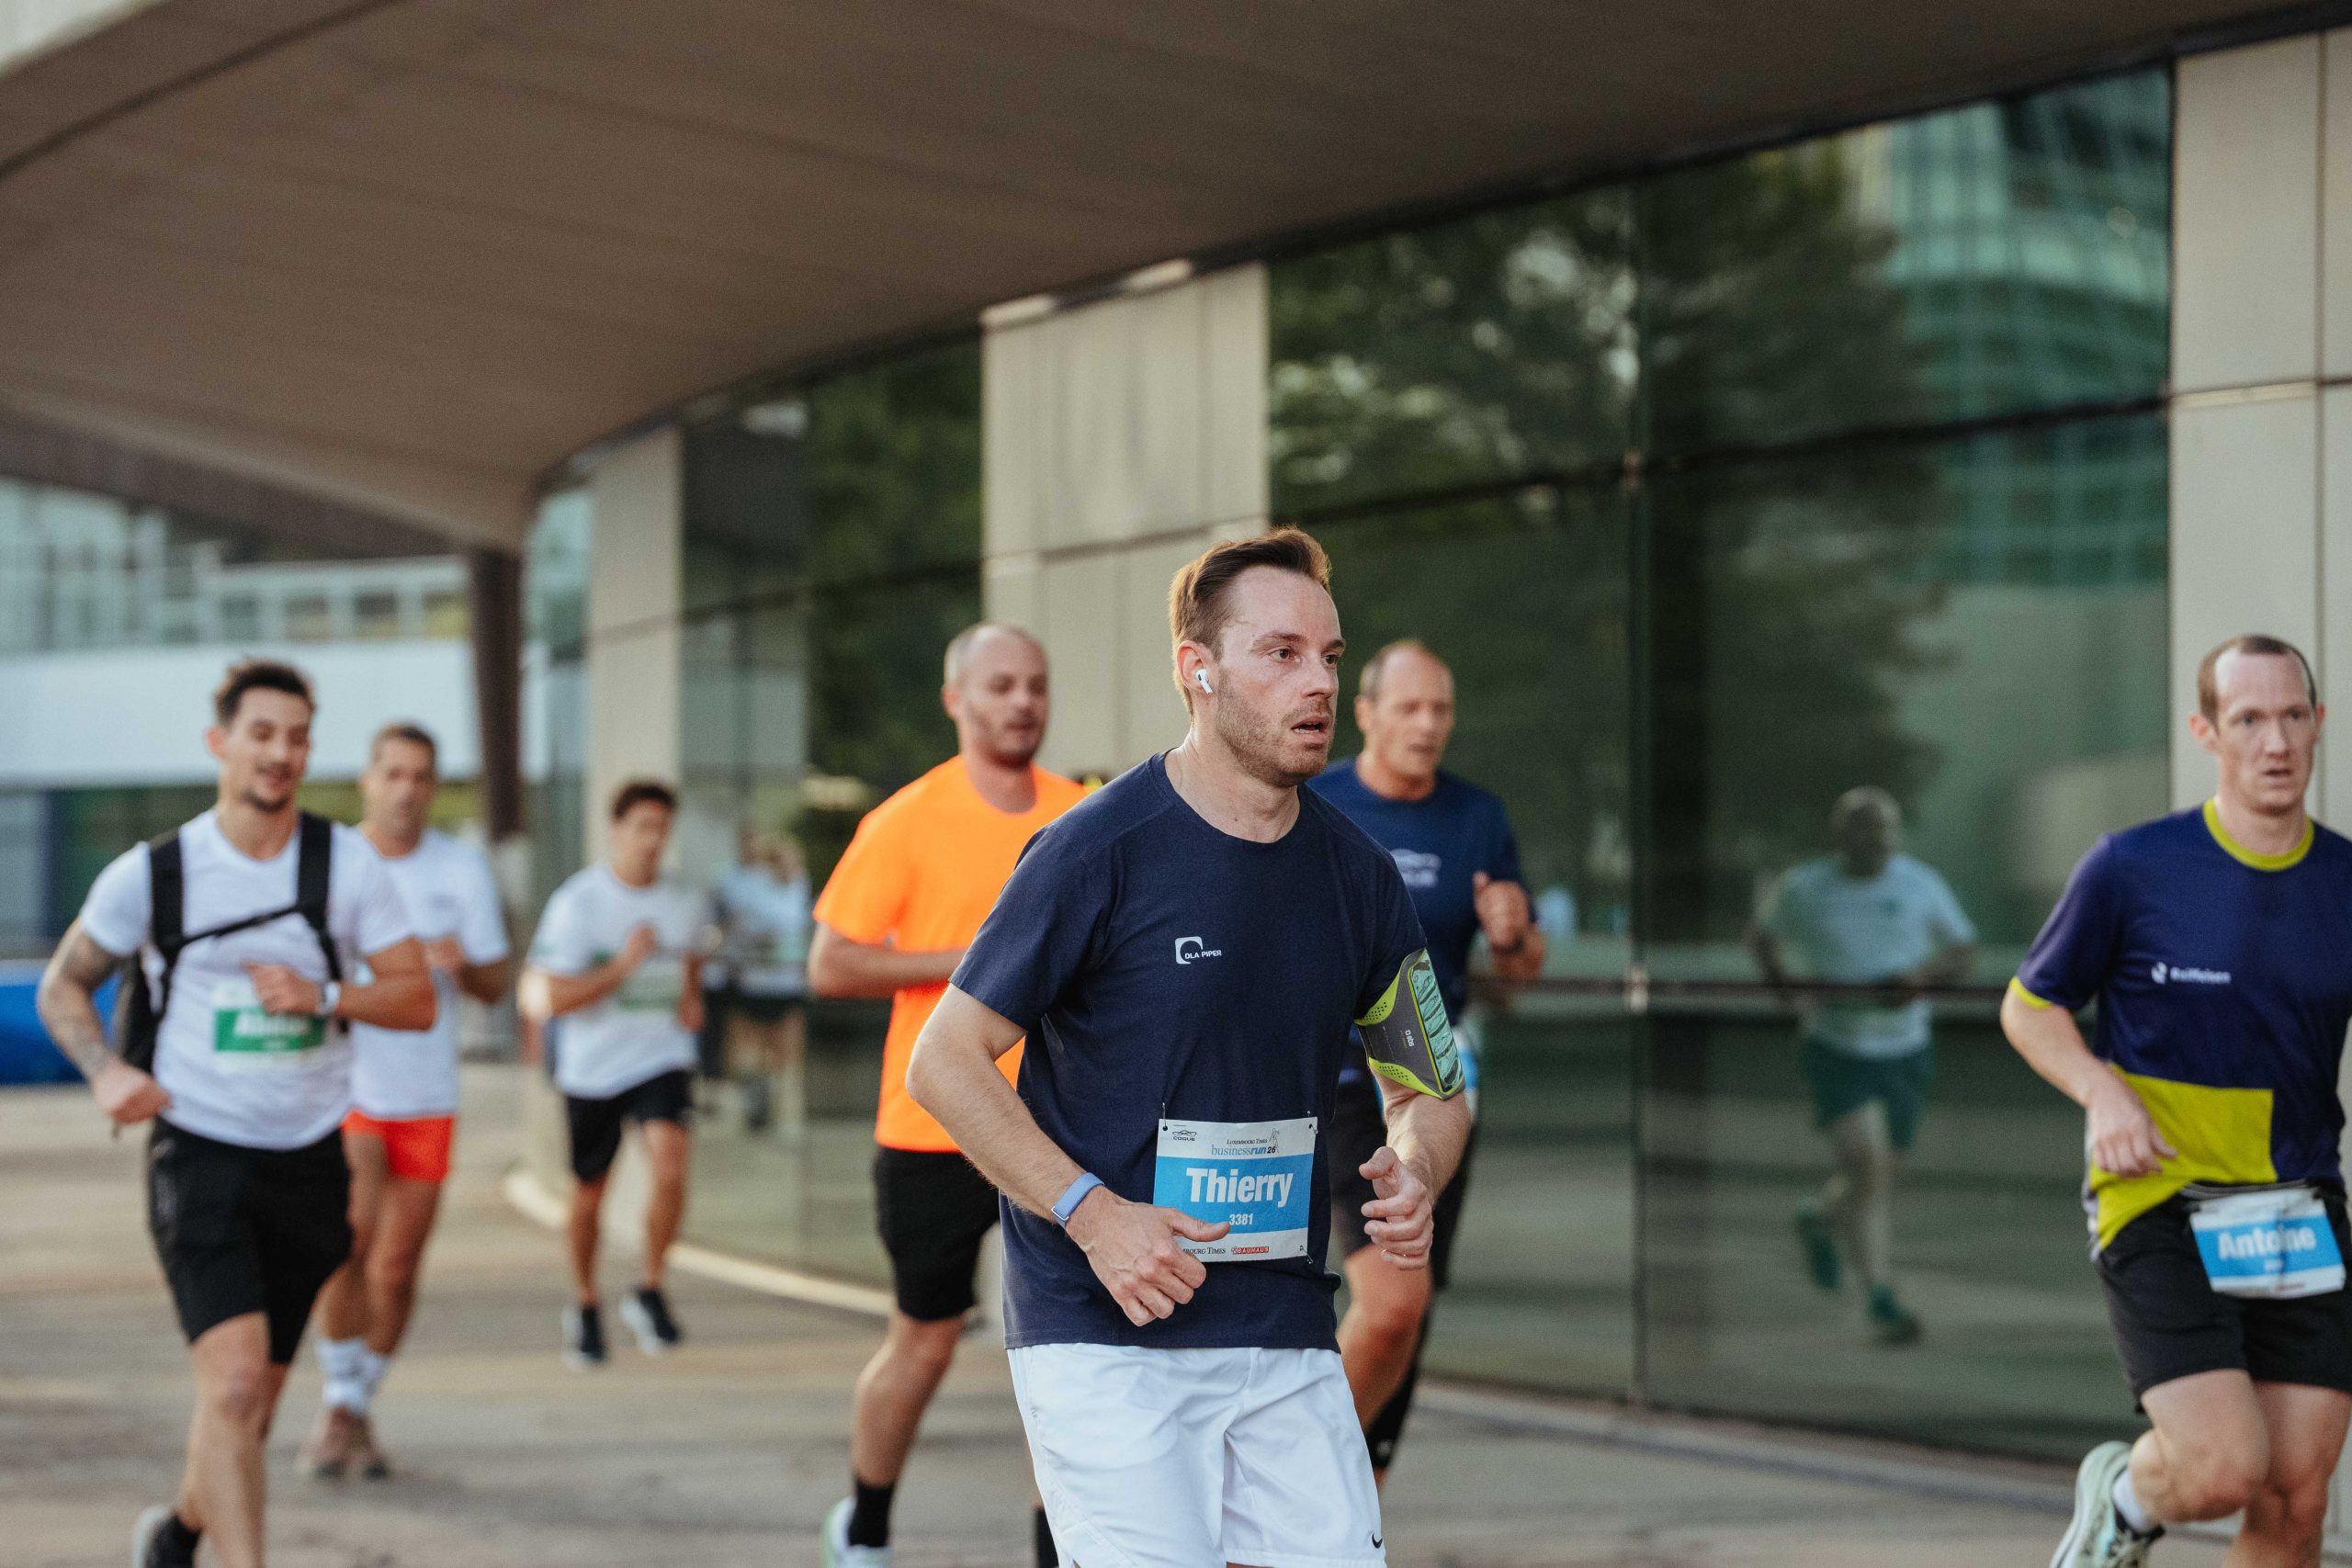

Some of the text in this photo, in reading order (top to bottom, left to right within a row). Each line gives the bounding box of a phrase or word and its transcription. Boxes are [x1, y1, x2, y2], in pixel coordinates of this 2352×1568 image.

[1201, 950, 1222, 958] PIPER
[1186, 1168, 1294, 1208] Thierry
[1228, 1213, 1253, 1225] 3381
